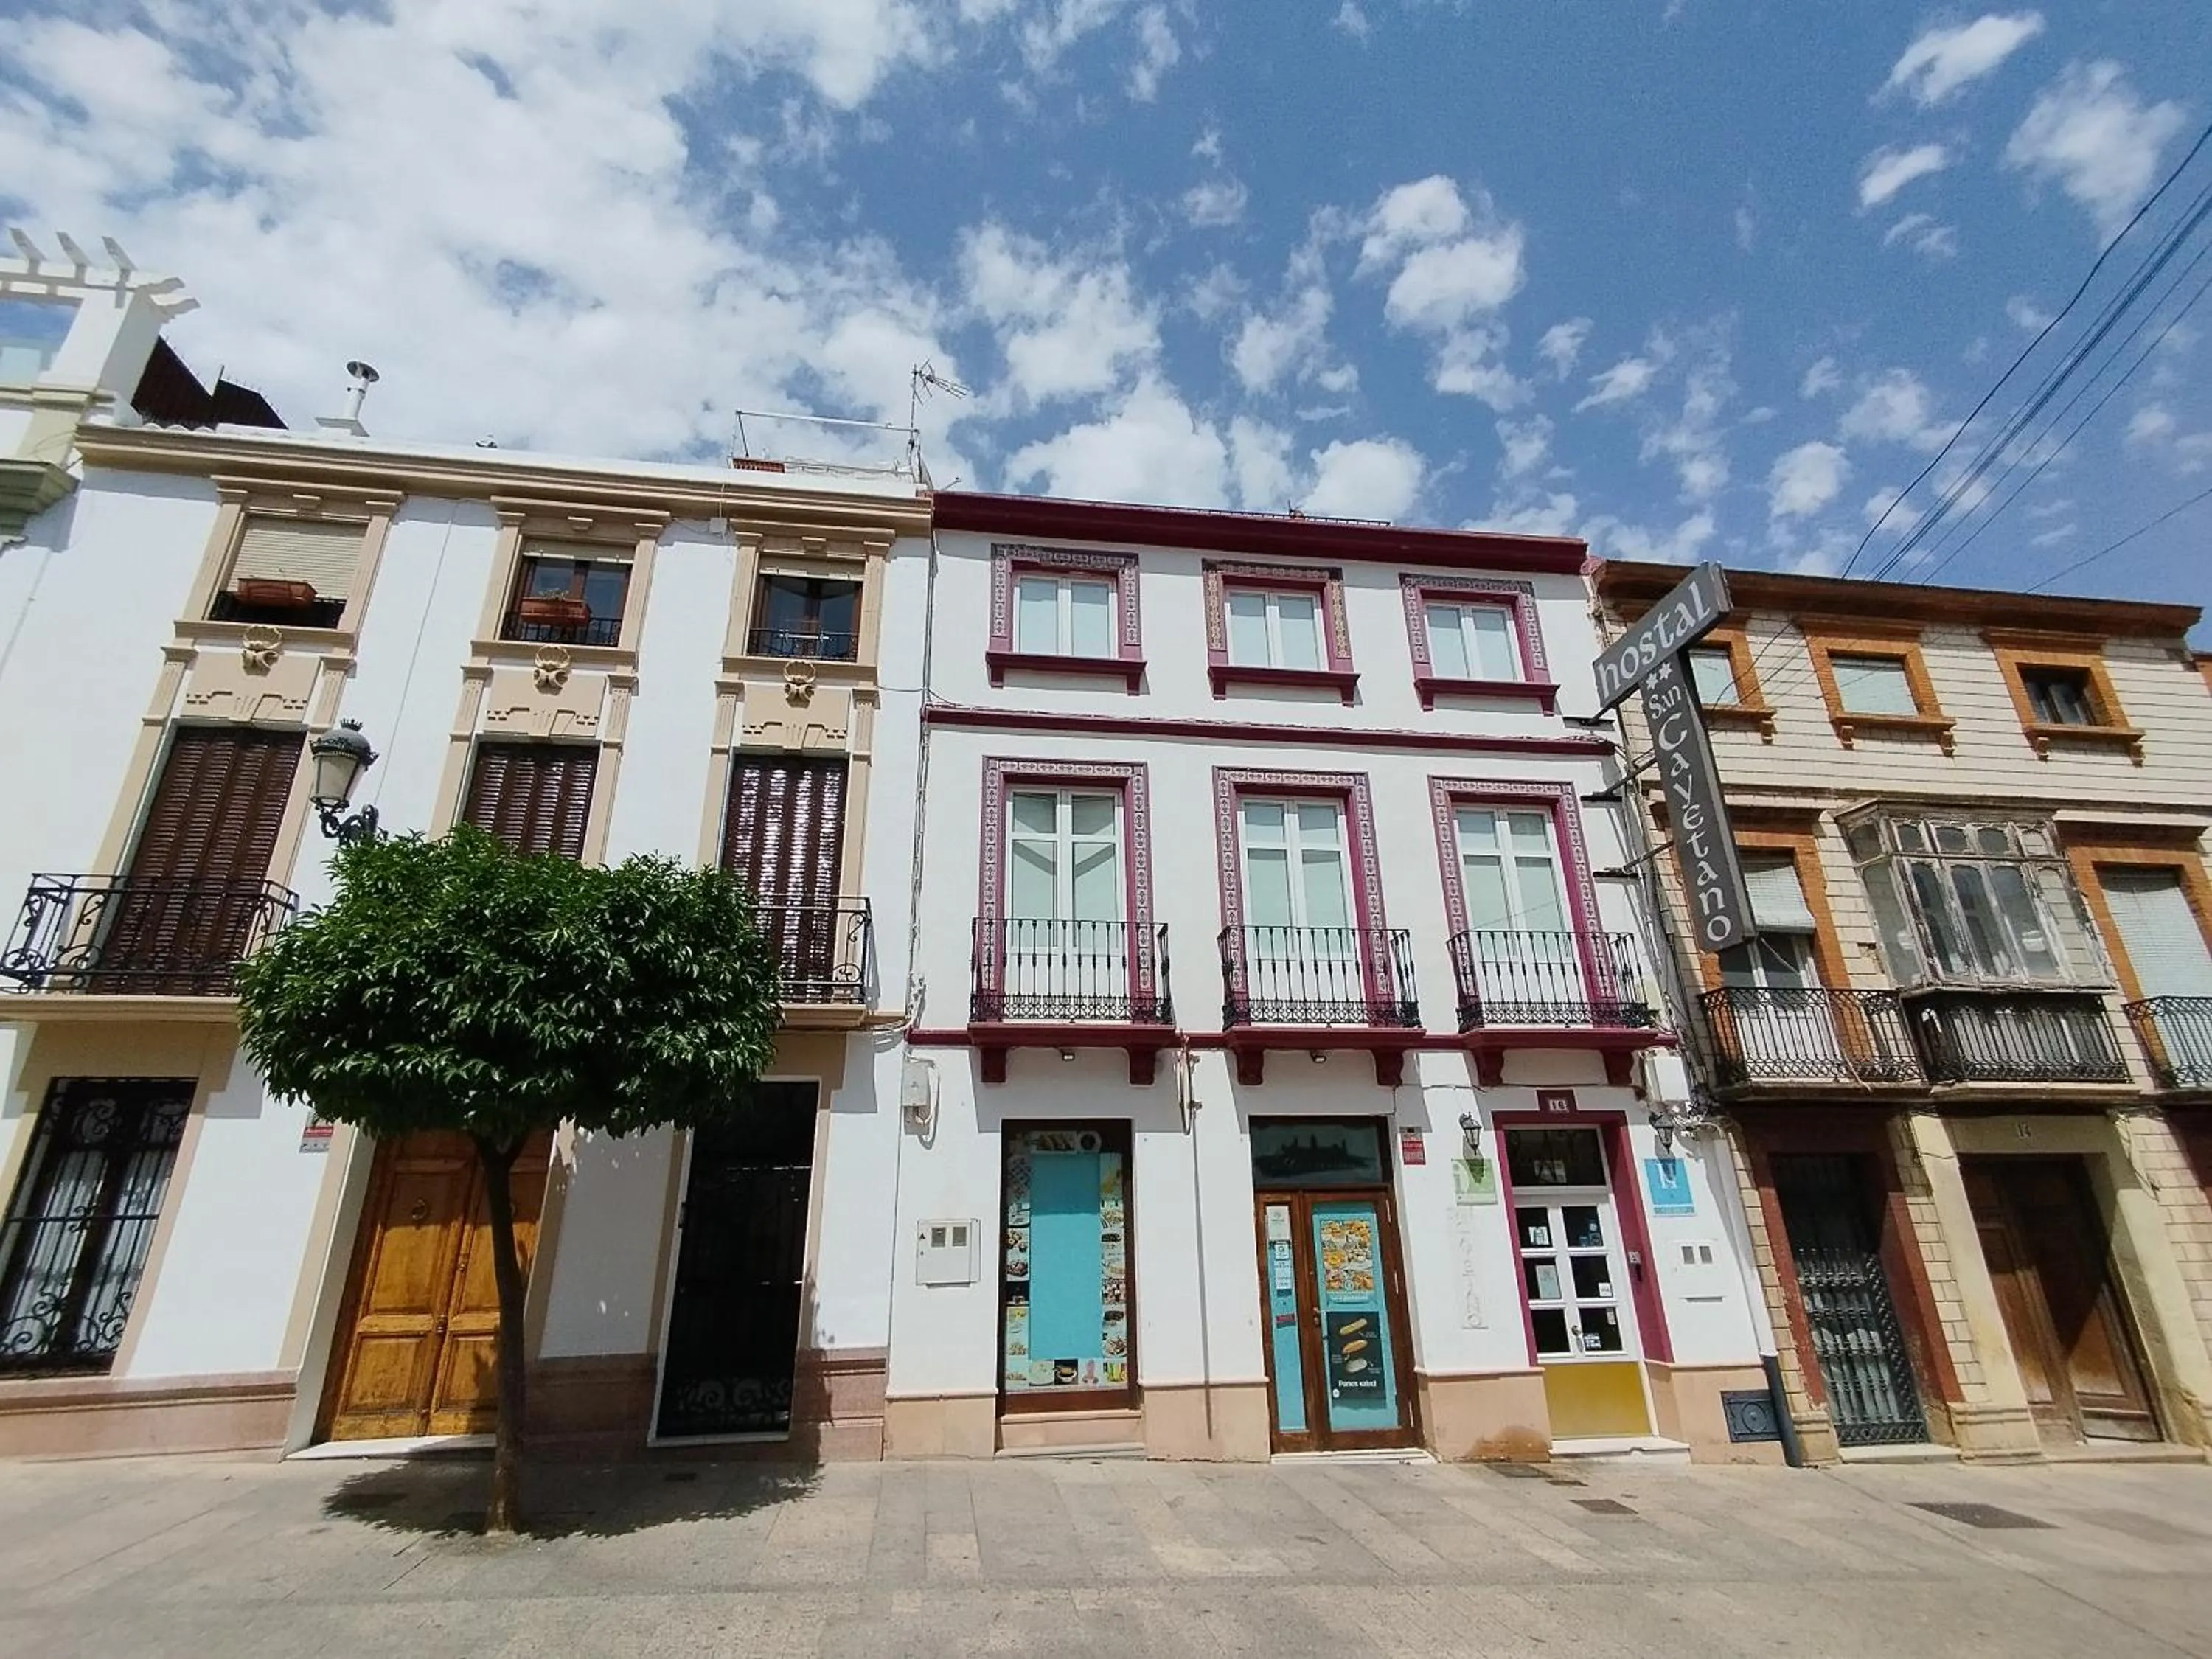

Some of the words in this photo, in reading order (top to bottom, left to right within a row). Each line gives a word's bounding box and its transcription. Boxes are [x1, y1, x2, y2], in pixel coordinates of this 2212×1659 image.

[1598, 581, 1711, 699] hostal
[1649, 685, 1682, 720] San
[1659, 712, 1731, 942] Cayetano
[1551, 1099, 1566, 1110] 16
